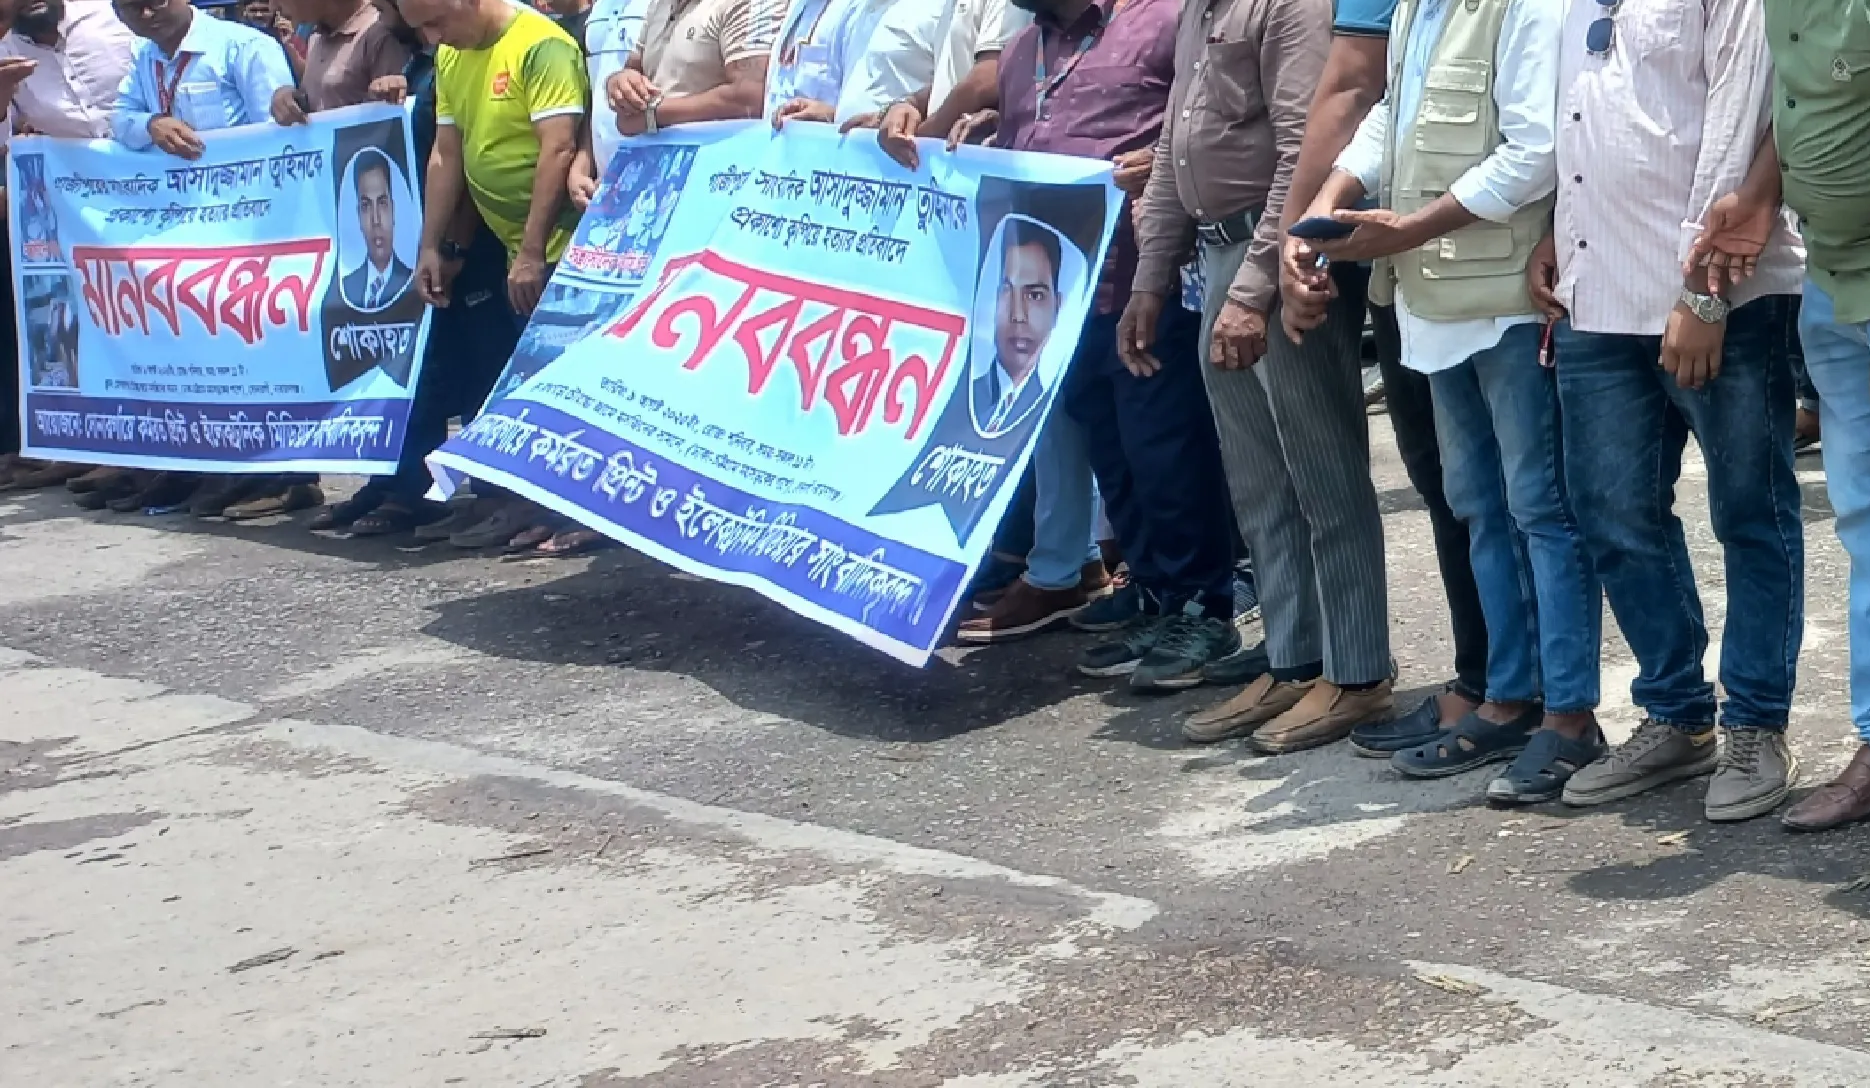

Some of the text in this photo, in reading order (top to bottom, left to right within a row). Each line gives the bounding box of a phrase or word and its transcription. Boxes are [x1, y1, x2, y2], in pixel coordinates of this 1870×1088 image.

[73, 238, 331, 344] মানববন্ধন
[331, 320, 415, 361] শোকাহত
[911, 442, 1006, 504] শোকাহত
[649, 486, 678, 517] ও
